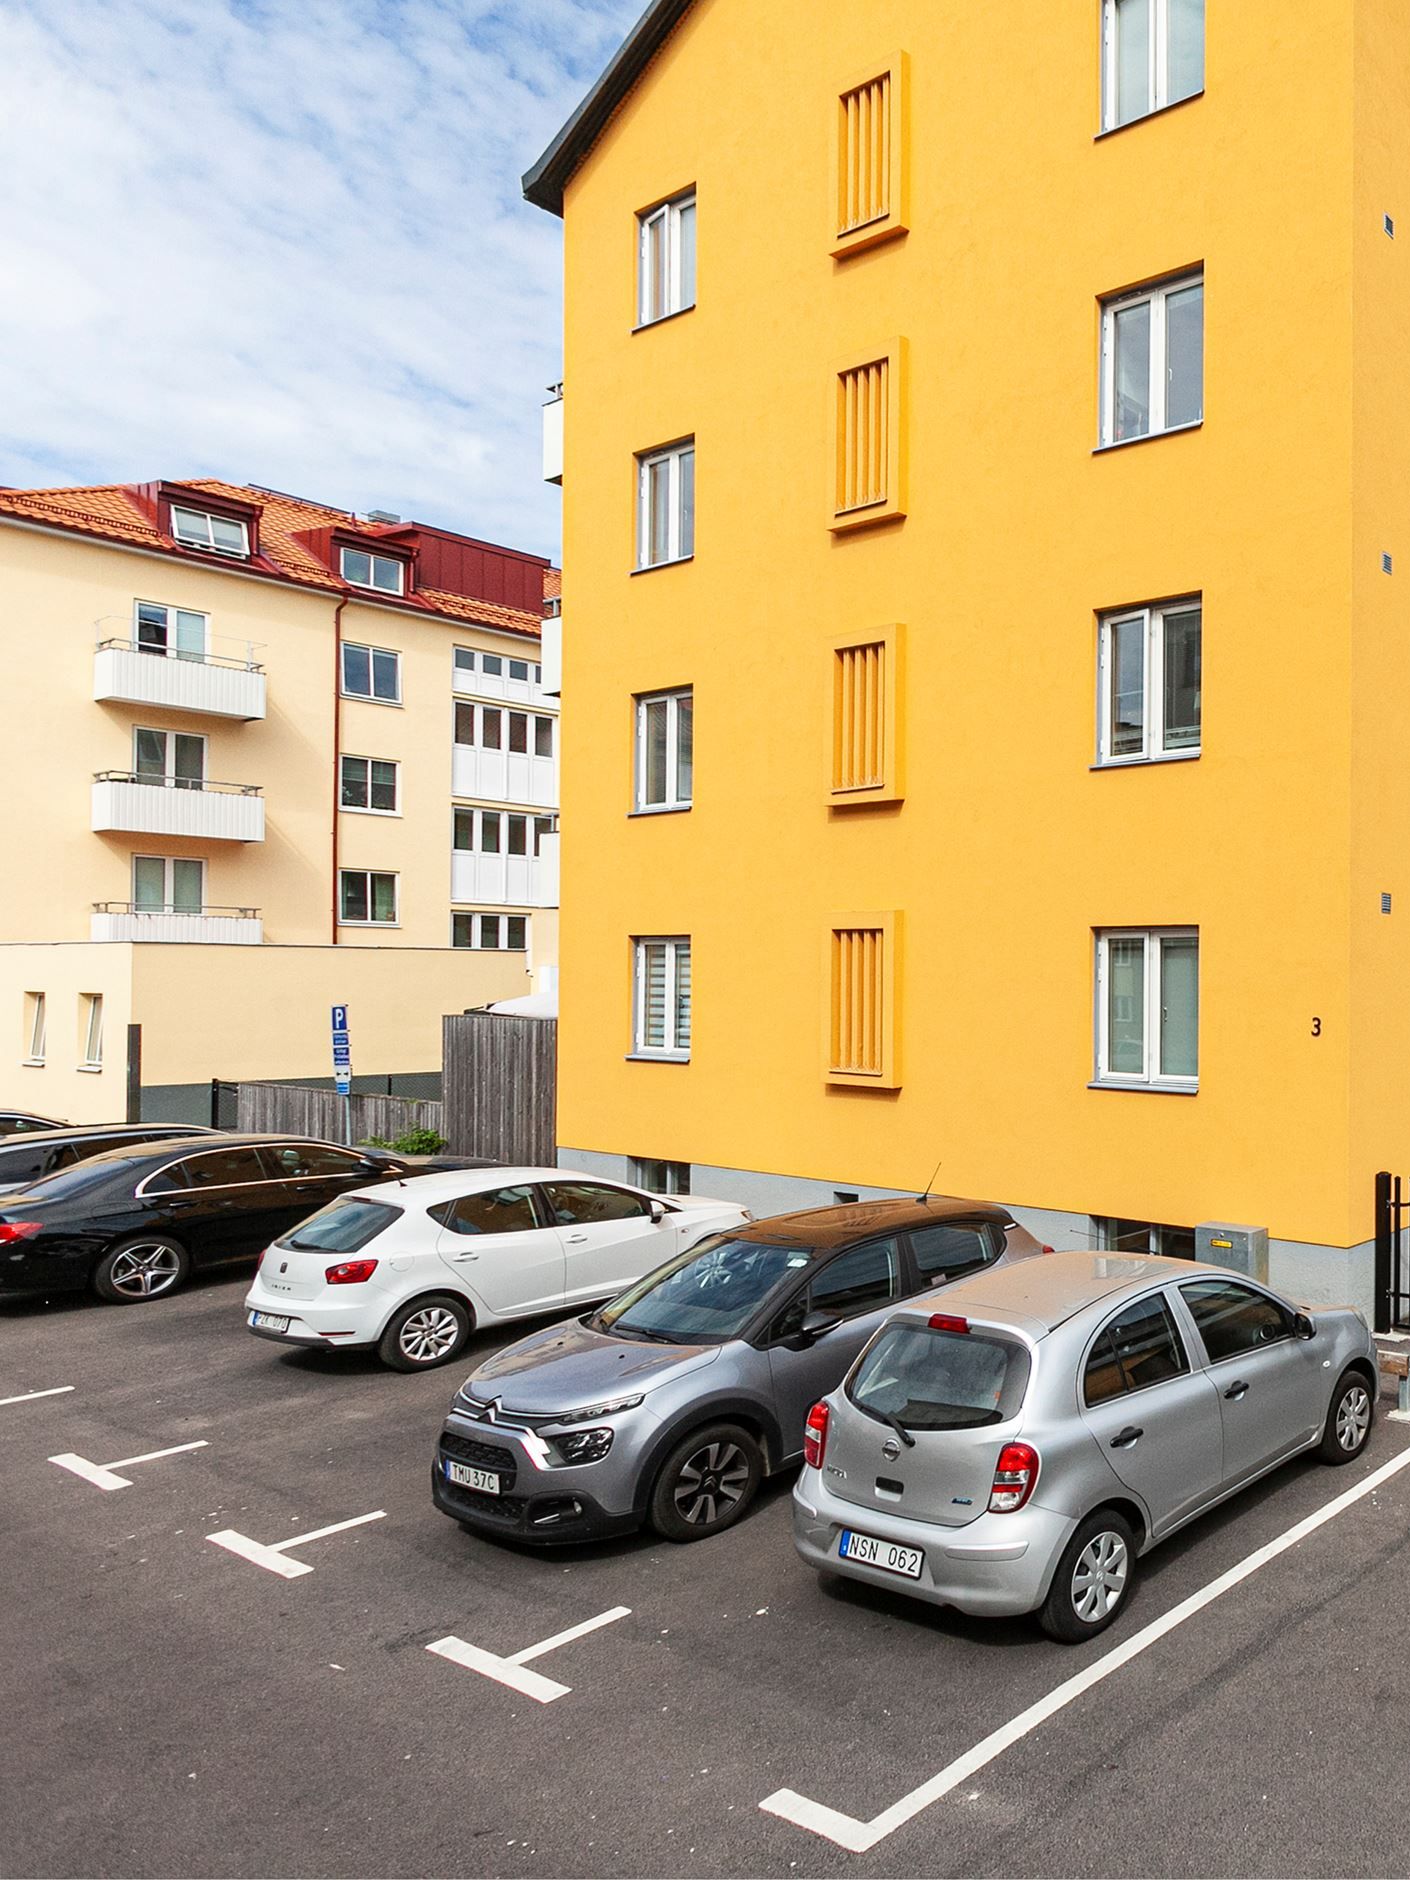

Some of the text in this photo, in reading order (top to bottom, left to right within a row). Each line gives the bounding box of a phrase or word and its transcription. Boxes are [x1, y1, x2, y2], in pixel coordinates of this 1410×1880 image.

[335, 1008, 344, 1029] P
[1311, 1016, 1321, 1037] 3
[452, 1463, 495, 1490] TMU 37C
[849, 1535, 918, 1573] NSN 062
